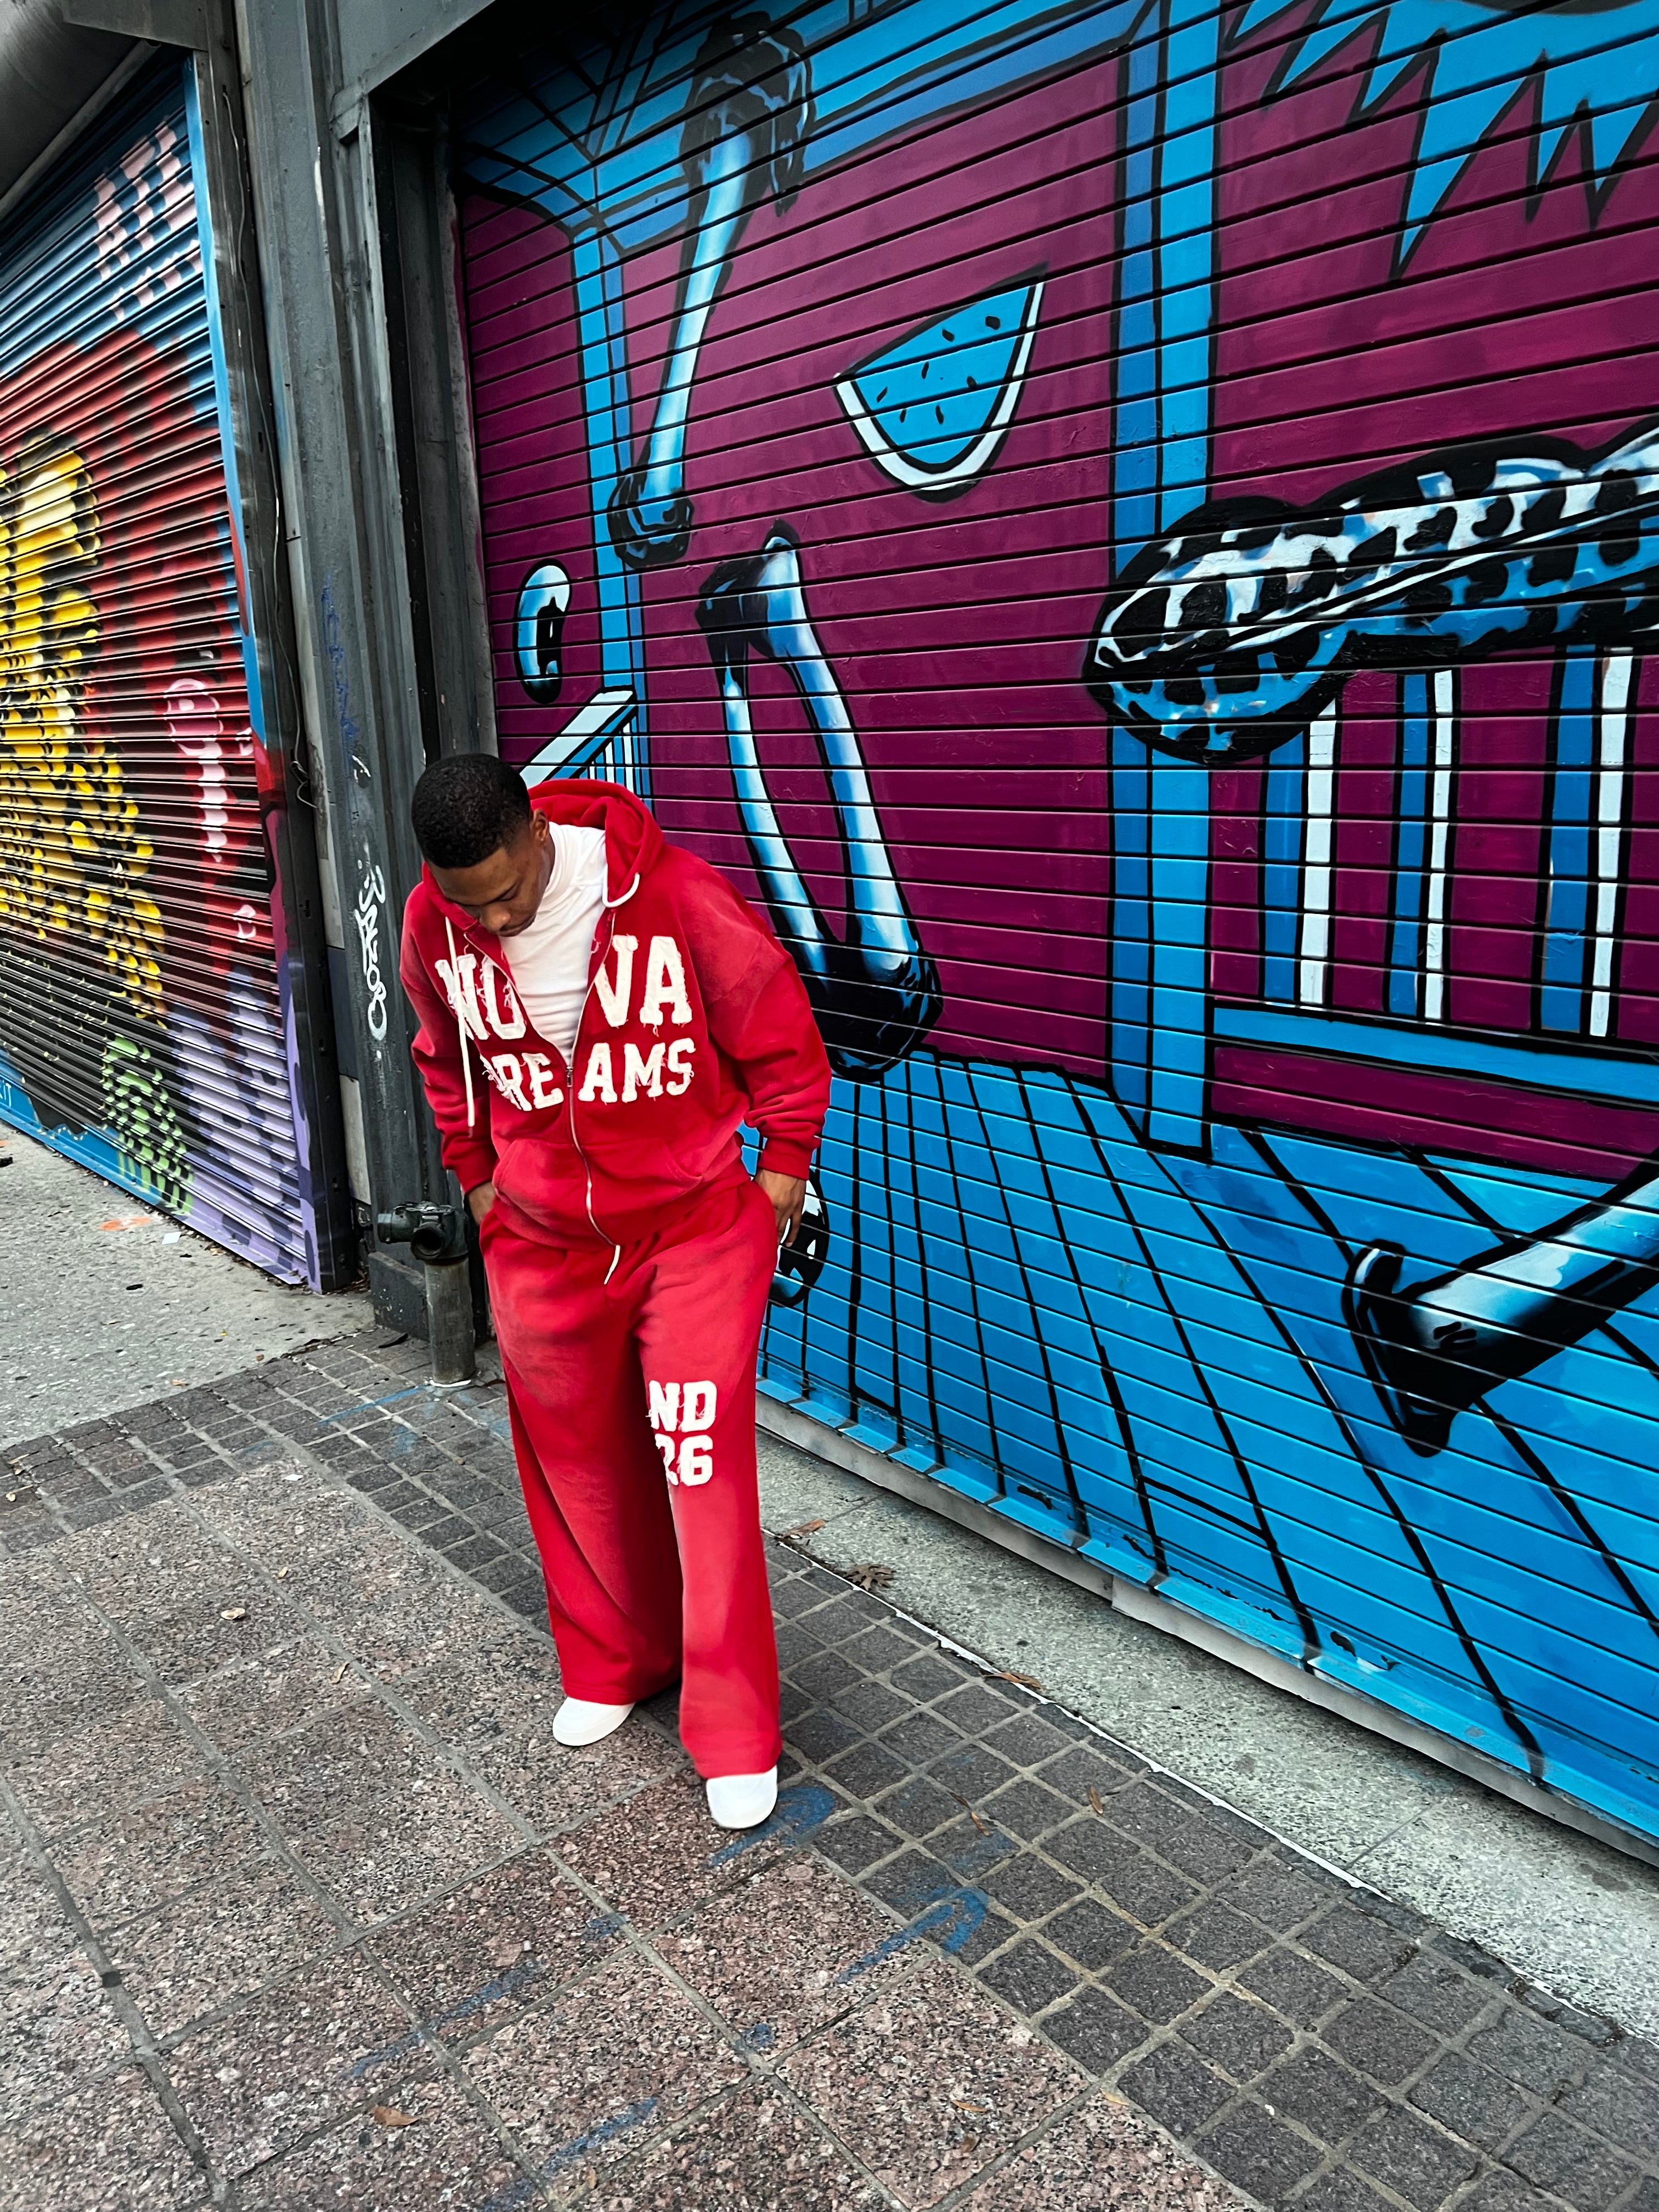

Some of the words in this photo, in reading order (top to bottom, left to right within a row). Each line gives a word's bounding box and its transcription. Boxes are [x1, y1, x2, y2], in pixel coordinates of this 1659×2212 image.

[481, 1037, 696, 1111] REAMS
[648, 1380, 717, 1432] ND
[655, 1433, 713, 1487] 26
